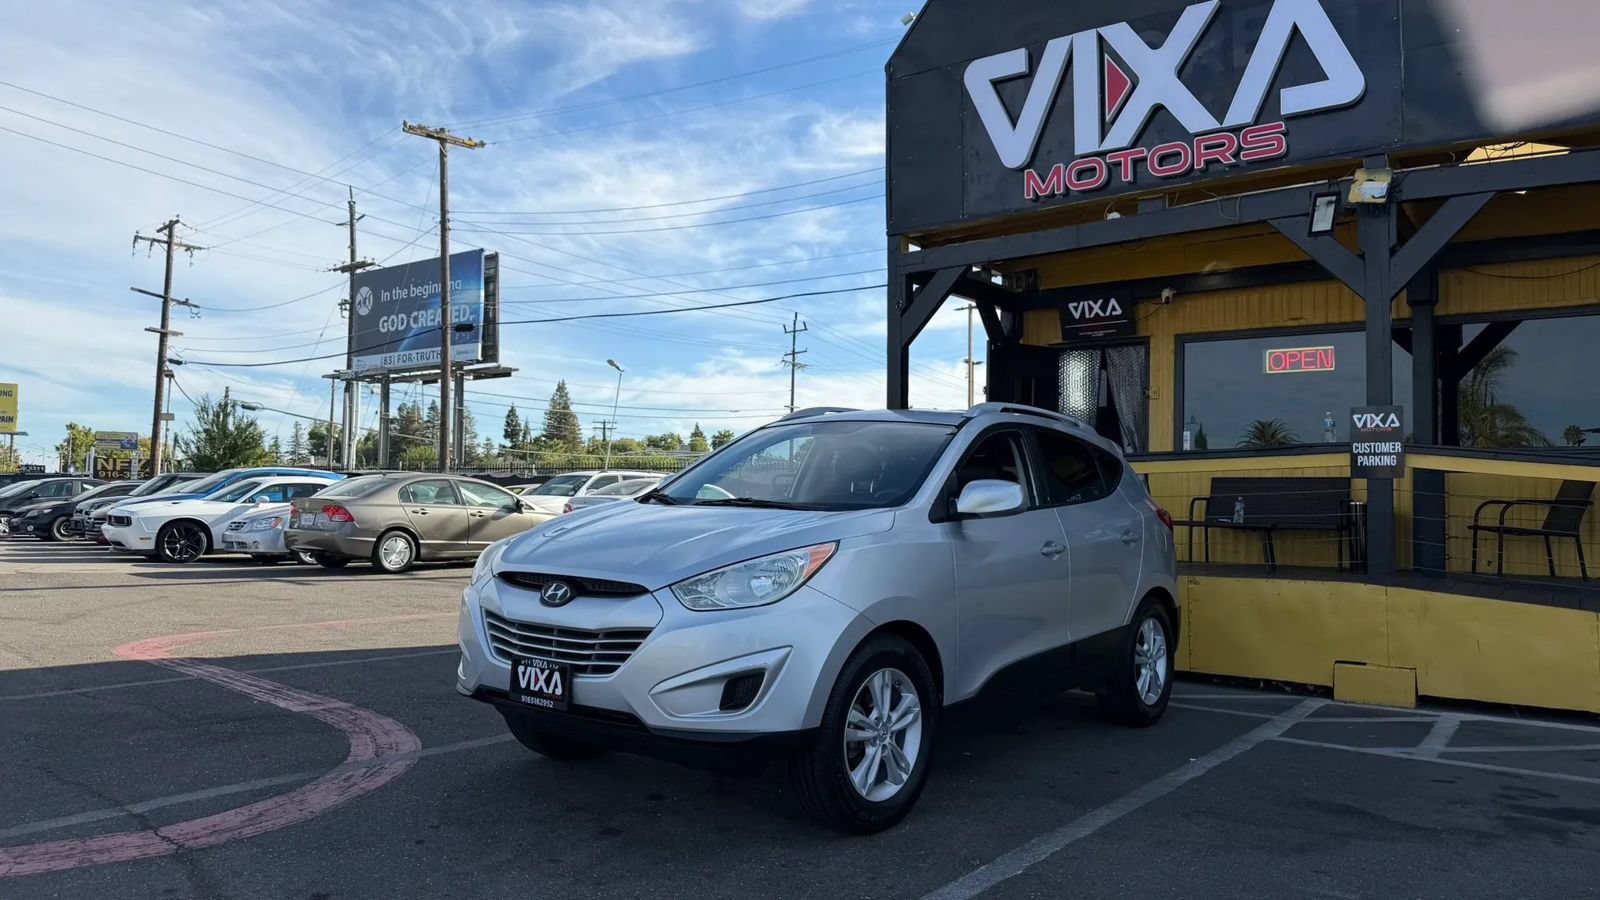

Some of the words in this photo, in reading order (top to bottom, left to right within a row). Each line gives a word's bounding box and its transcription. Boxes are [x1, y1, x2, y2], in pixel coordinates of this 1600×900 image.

[963, 0, 1367, 170] VIXA
[1023, 121, 1288, 199] MOTORS
[381, 289, 390, 302] In
[392, 286, 408, 299] the
[410, 279, 462, 298] beginng
[1068, 298, 1122, 319] VIXA
[379, 313, 407, 333] GOD
[409, 304, 473, 328] CREAED.
[380, 355, 395, 366] (83)
[1270, 348, 1332, 370] OPEN
[0, 415, 14, 423] AIN
[1352, 413, 1400, 428] VIXA
[1352, 442, 1401, 453] CUSTOMER
[1357, 455, 1396, 466] PARKING
[98, 471, 149, 479] 916-33-
[532, 659, 548, 669] VIXA
[517, 665, 563, 695] VIXA
